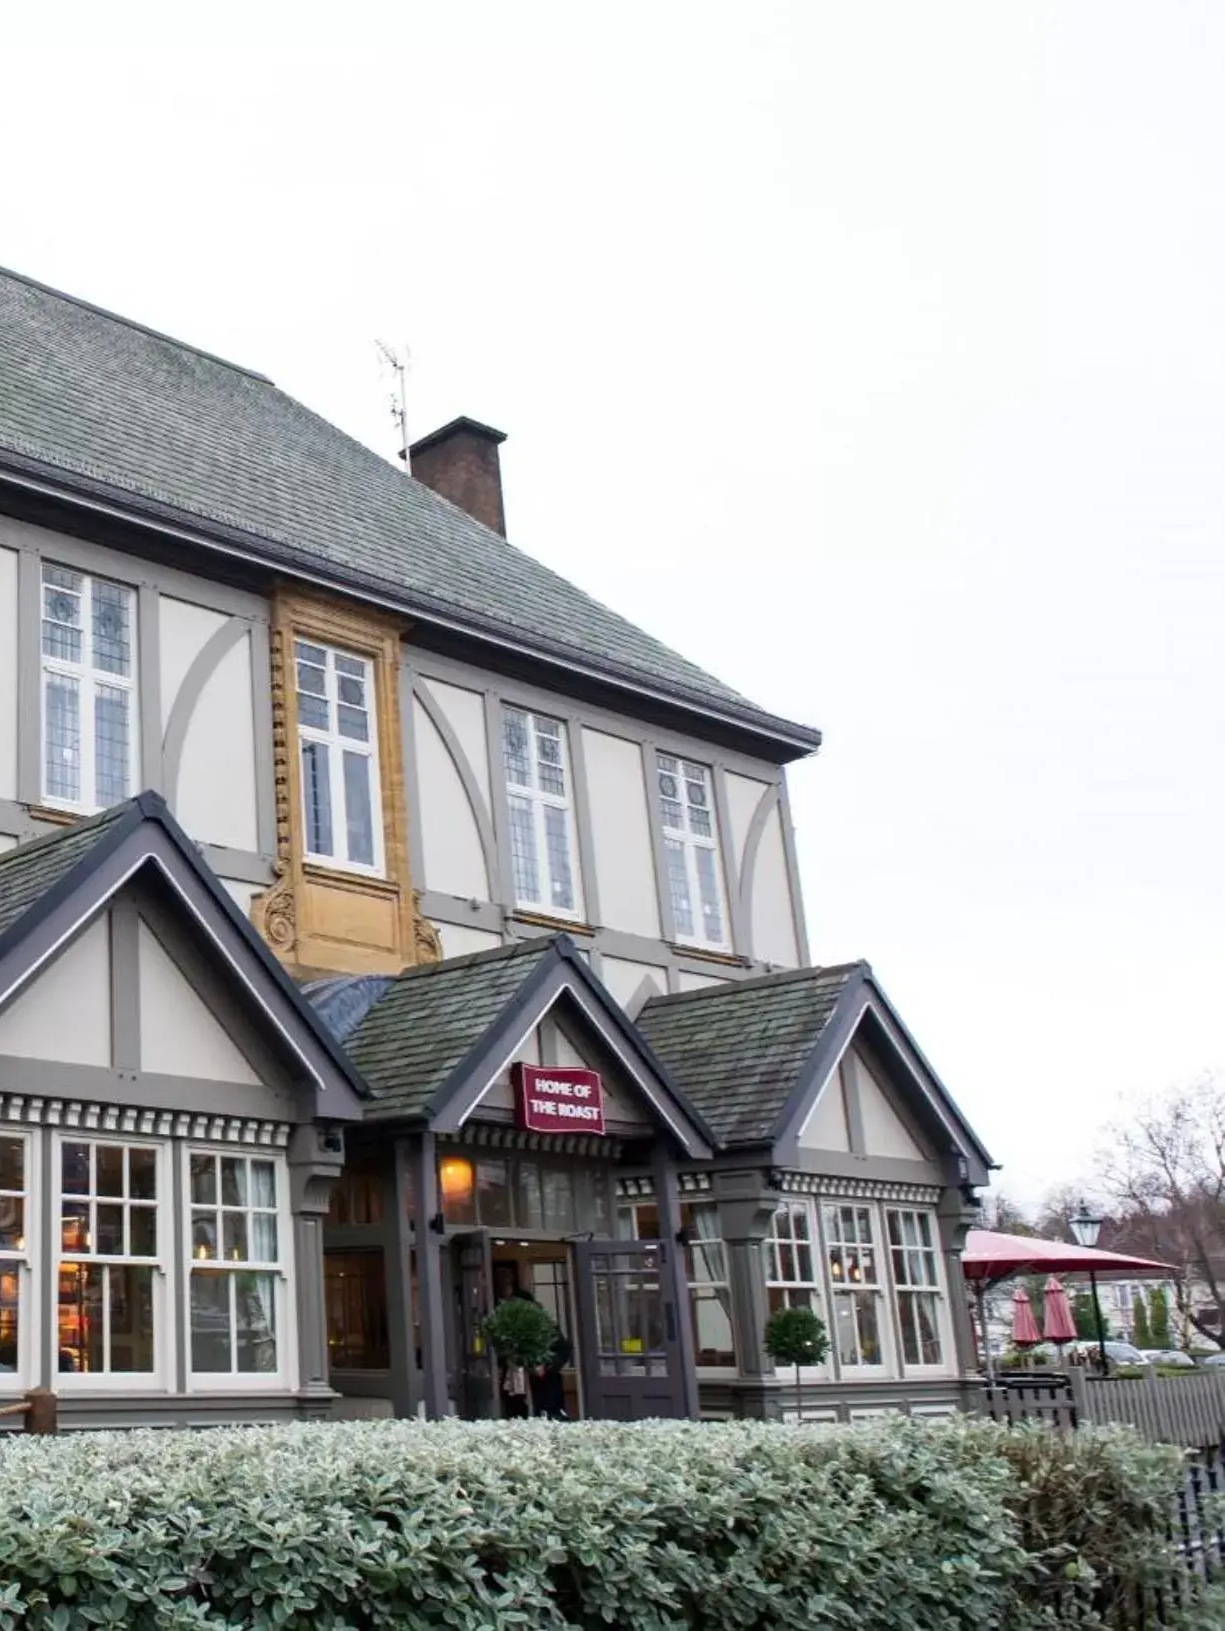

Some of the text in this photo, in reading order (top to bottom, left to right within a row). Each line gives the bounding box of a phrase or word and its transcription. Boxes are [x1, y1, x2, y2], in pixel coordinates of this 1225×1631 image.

[535, 1078, 592, 1098] HOME OF
[529, 1099, 599, 1120] THE ROAST
